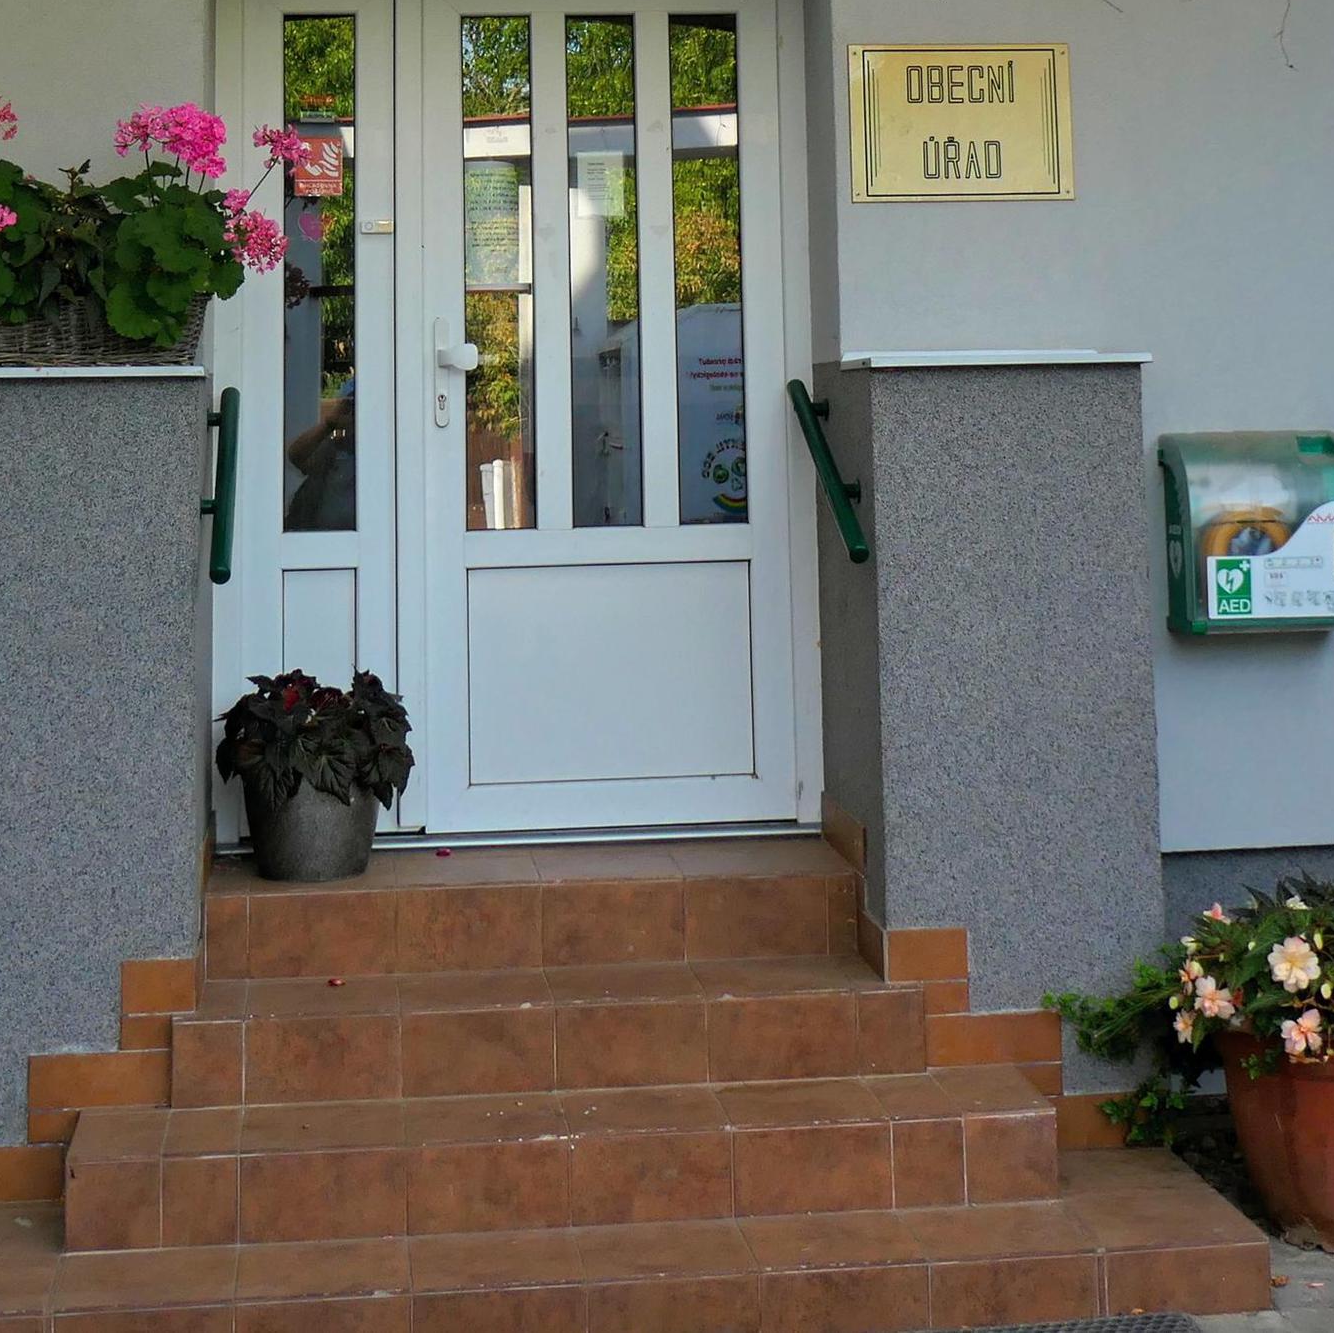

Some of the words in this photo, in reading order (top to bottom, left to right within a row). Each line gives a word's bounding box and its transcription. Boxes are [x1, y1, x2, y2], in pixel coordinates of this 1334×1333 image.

[906, 60, 1015, 104] OBECNÍ
[923, 136, 1002, 179] ÚŘAD
[1218, 599, 1251, 613] AED
